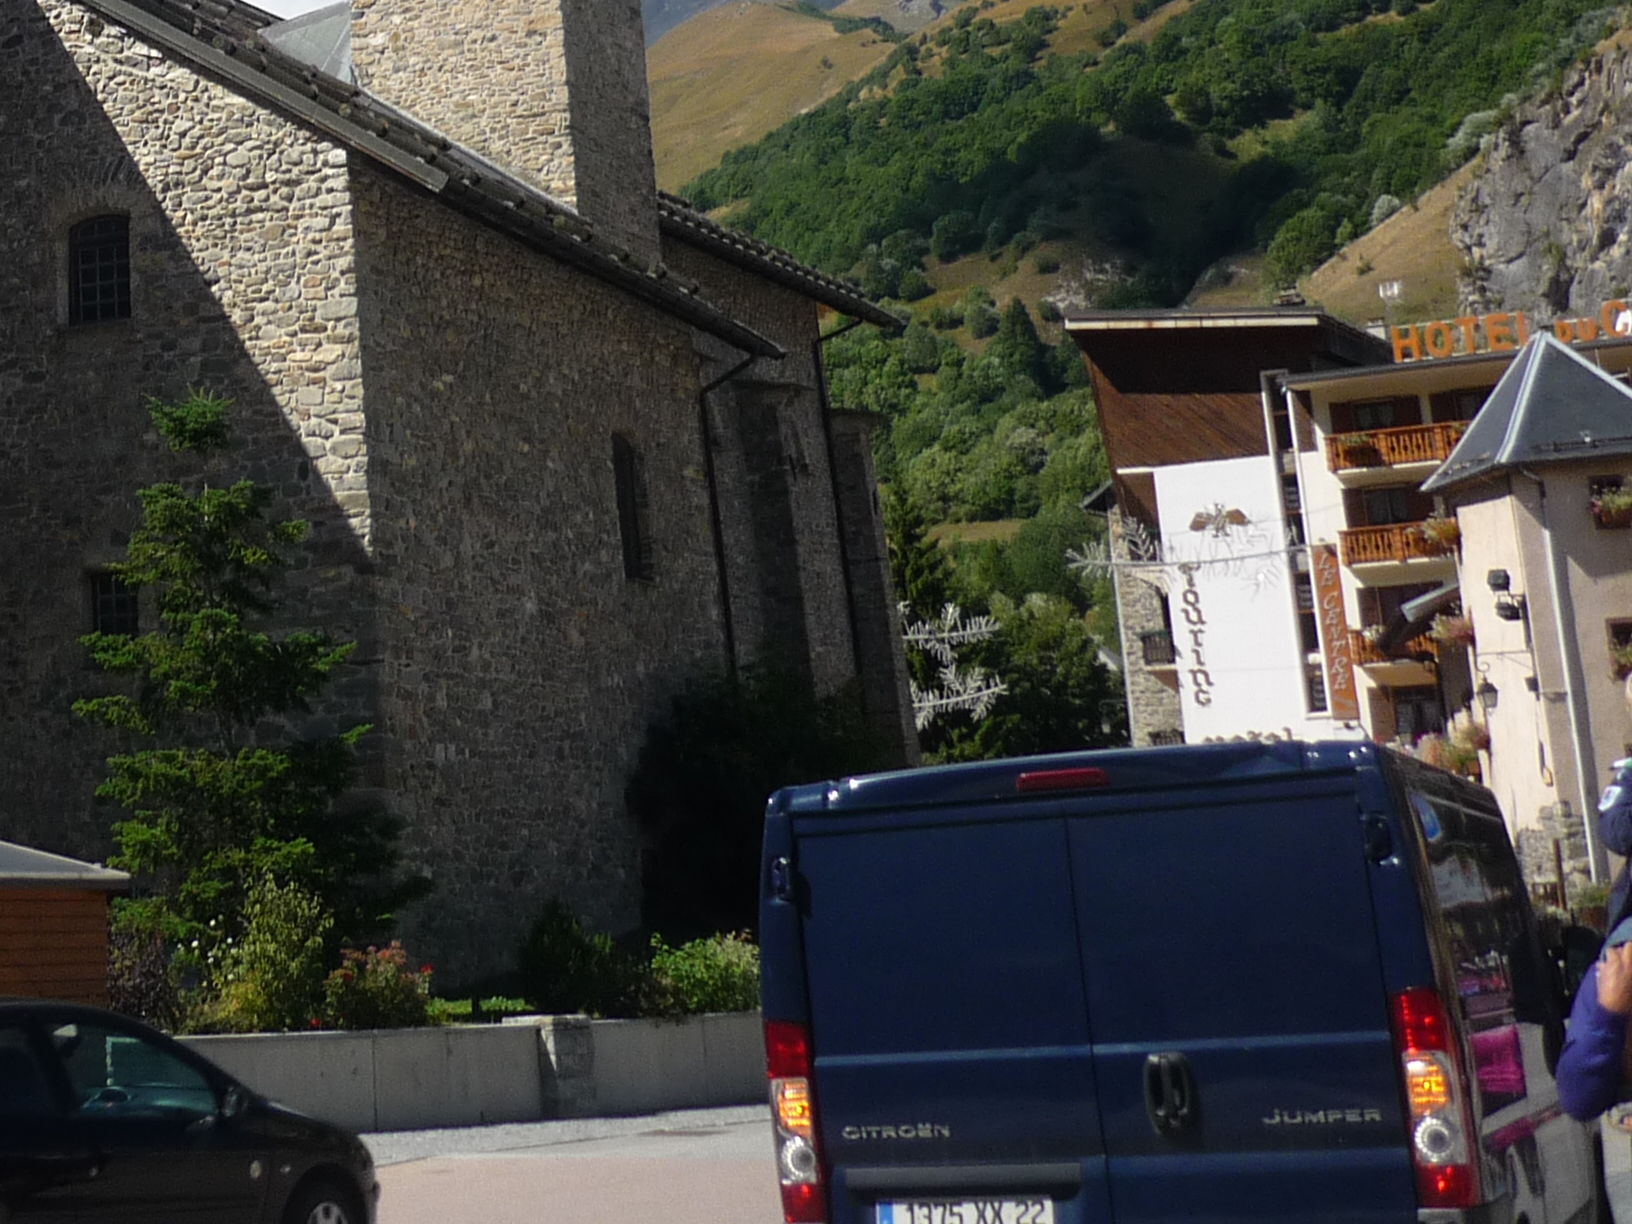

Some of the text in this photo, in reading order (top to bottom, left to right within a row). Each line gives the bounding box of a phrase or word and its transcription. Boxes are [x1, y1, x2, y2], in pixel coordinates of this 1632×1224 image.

[1555, 316, 1598, 344] DU
[1323, 591, 1349, 691] CENTRE
[1262, 1108, 1383, 1124] JUMPER
[841, 1122, 952, 1140] CITROËN
[906, 1198, 1046, 1224] 1375 XX 22
